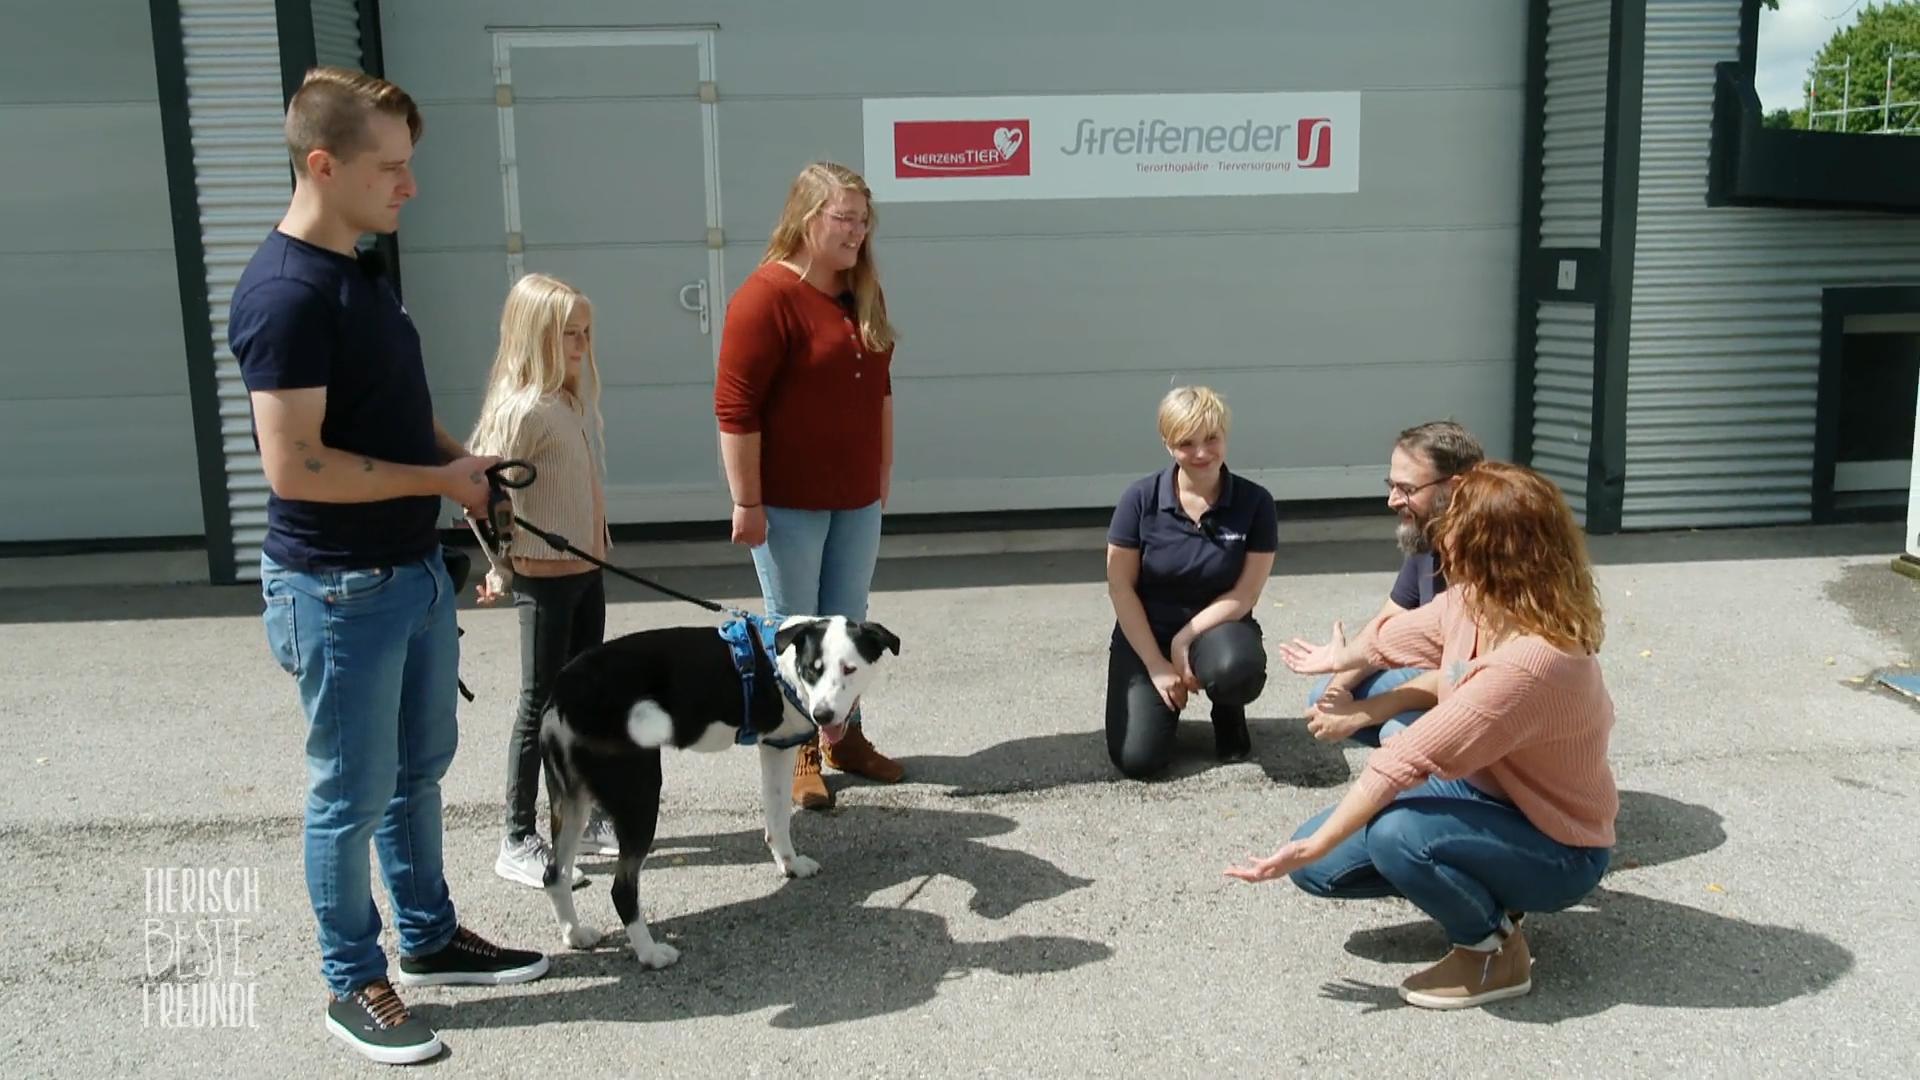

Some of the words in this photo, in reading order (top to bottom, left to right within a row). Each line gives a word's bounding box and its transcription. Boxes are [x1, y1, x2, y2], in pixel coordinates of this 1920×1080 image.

[1060, 118, 1292, 156] Streifeneder
[913, 149, 1000, 165] HERZENSTIER
[1136, 161, 1209, 173] Tierorthopädie
[1218, 160, 1291, 173] Tierversorgung
